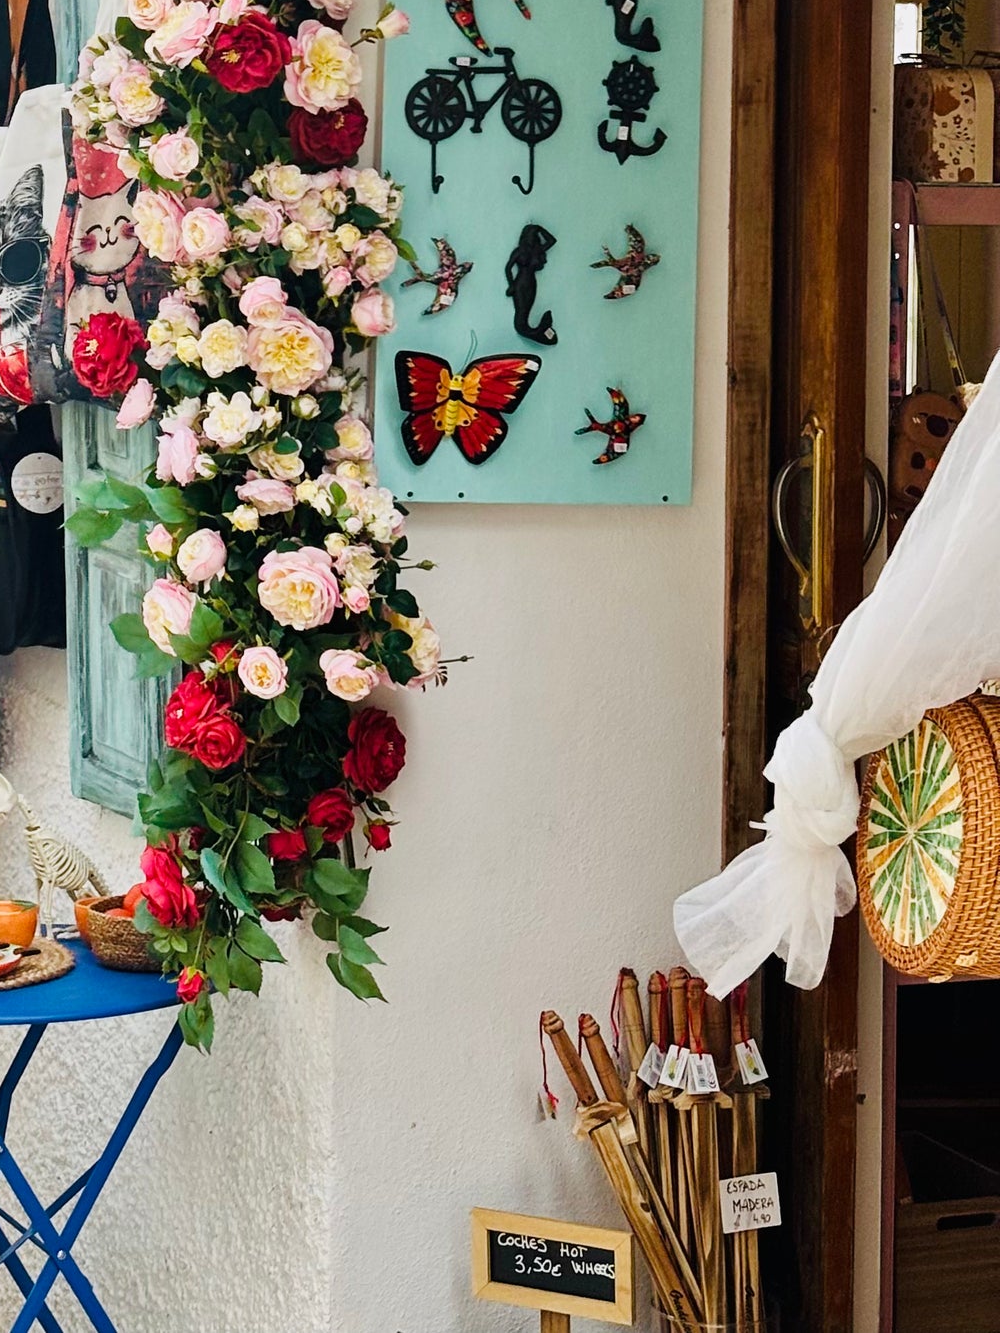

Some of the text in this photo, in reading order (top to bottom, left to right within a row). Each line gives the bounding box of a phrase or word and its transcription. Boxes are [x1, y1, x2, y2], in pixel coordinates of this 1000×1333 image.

[727, 1178, 766, 1194] ESPADA
[732, 1197, 774, 1214] MADERA
[497, 1232, 589, 1258] COCHES HOT
[514, 1254, 616, 1280] 3,50€ WHEELS
